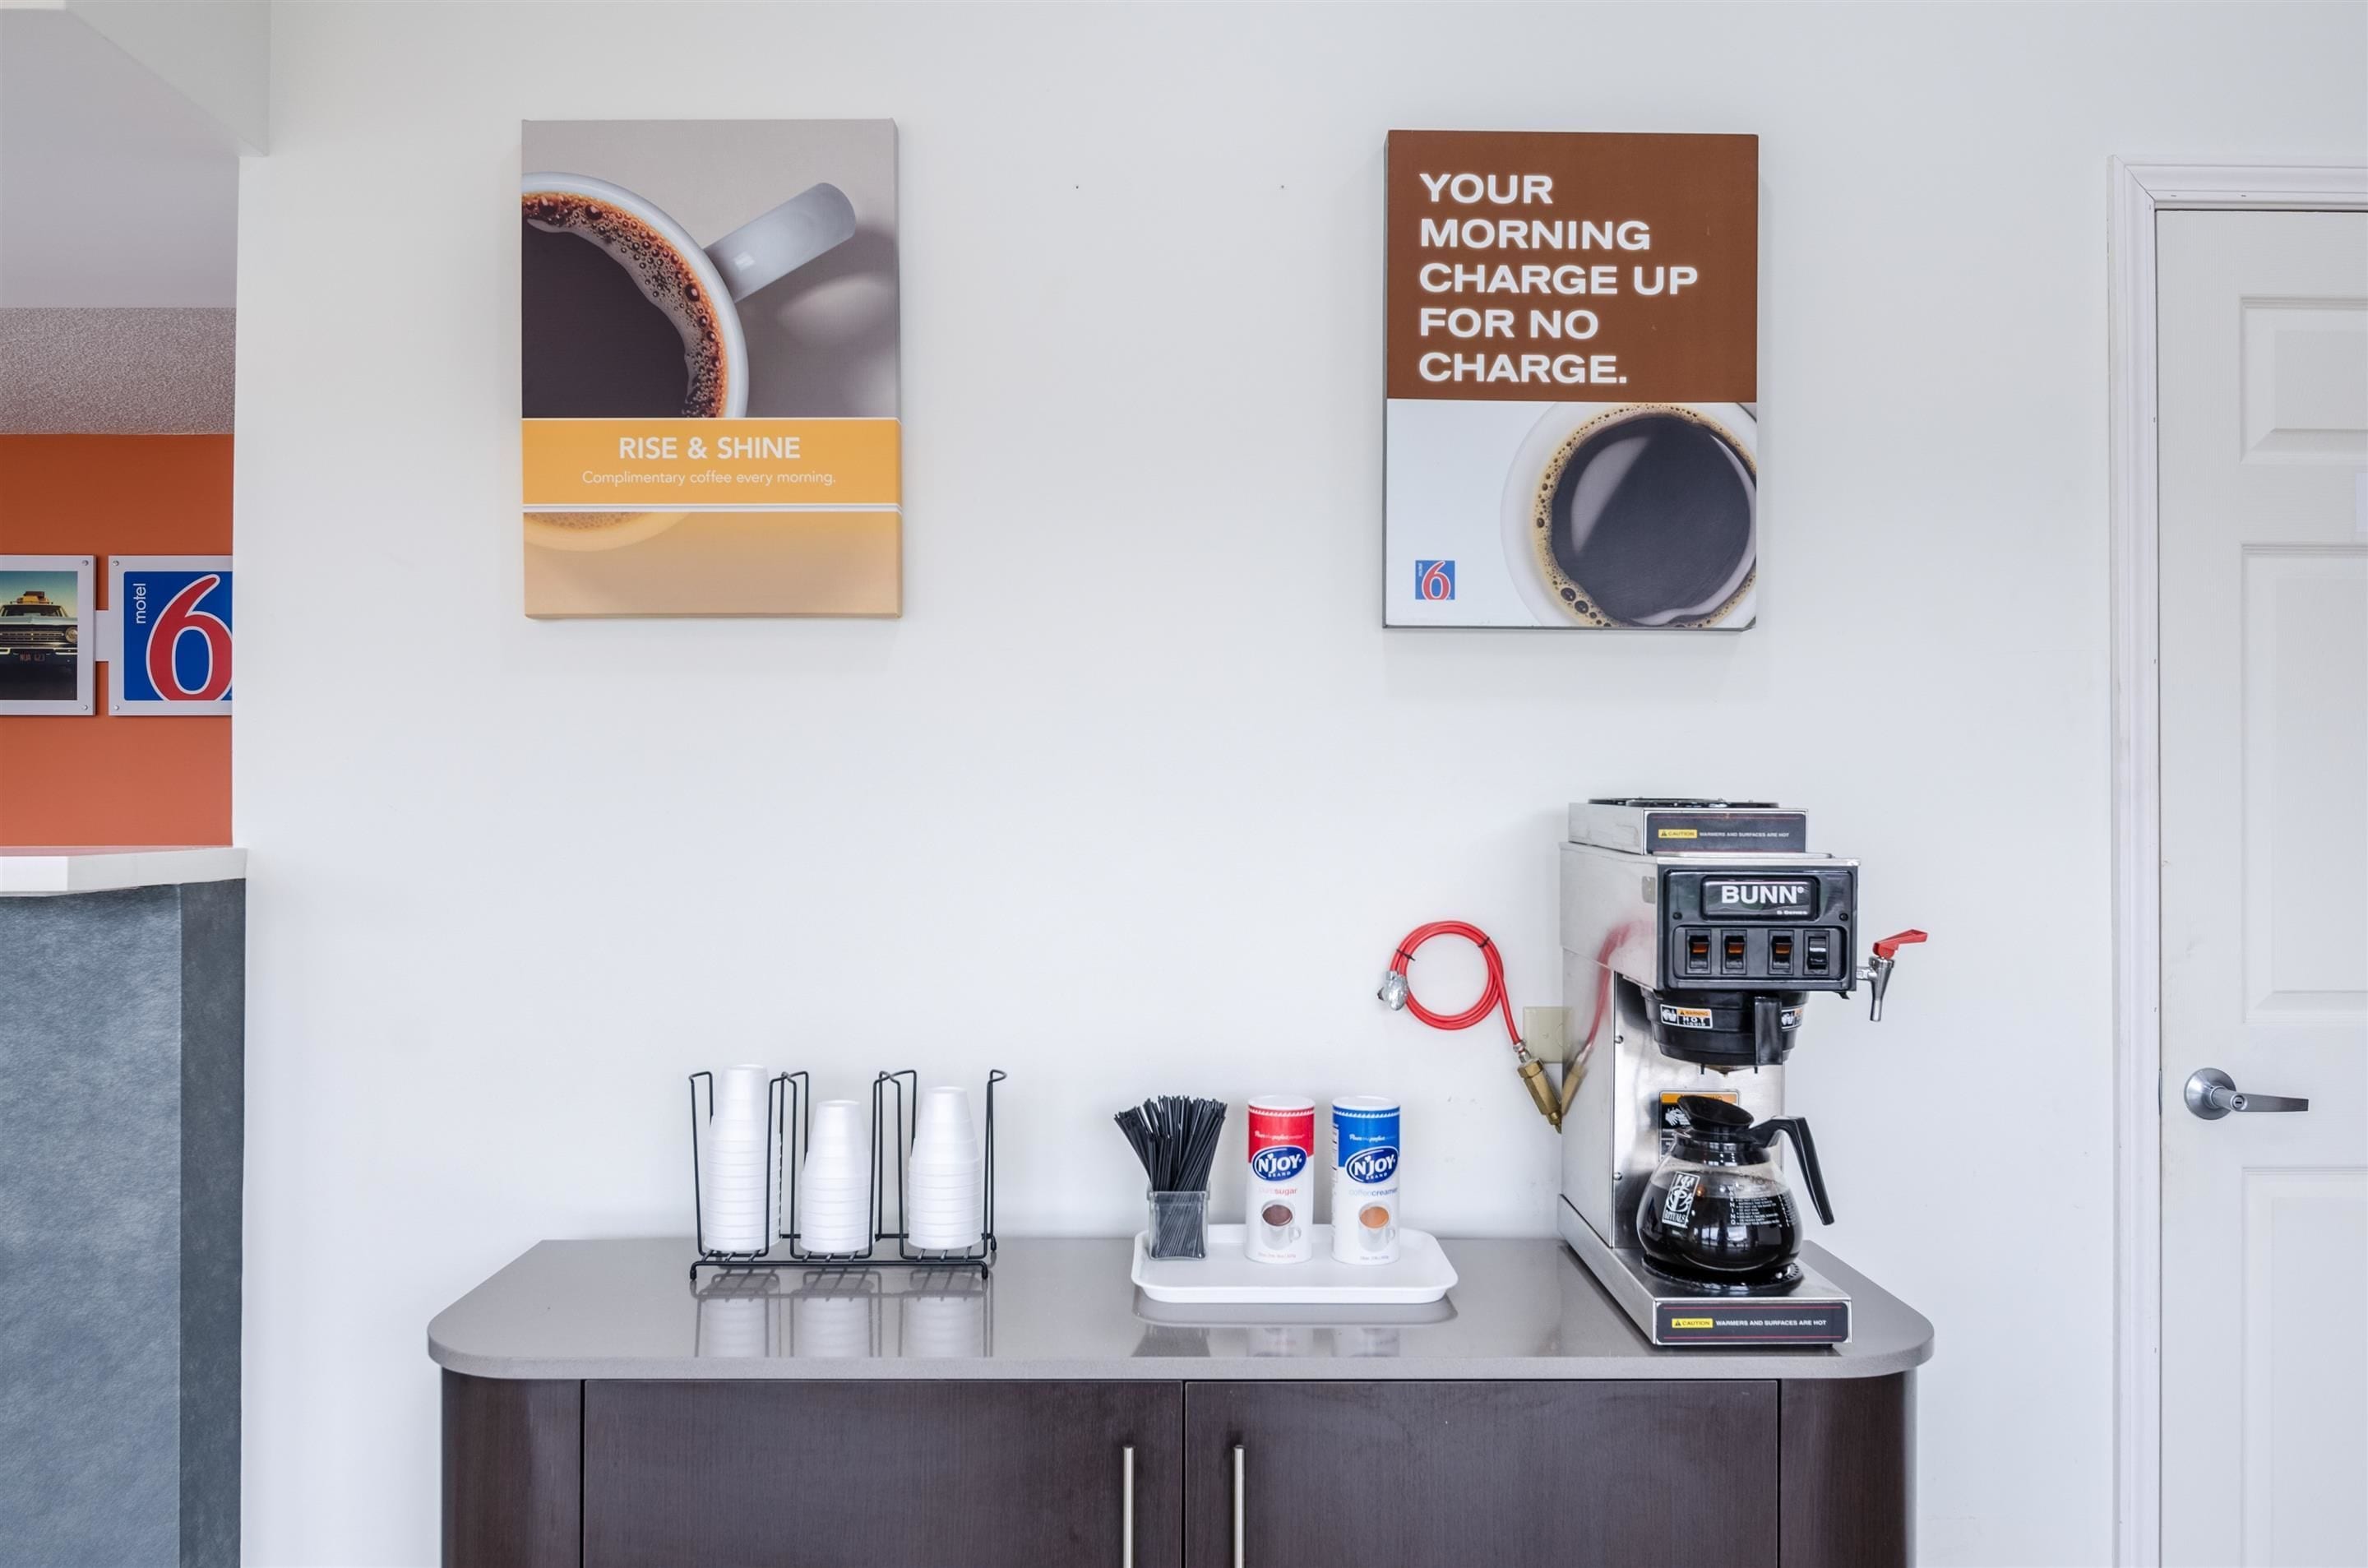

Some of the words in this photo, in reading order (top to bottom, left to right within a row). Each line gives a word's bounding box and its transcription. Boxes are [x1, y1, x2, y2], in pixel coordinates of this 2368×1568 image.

[1419, 173, 1554, 204] YOUR
[1420, 219, 1651, 250] MORNING
[1419, 263, 1618, 294] CHARGE
[1634, 266, 1698, 295] UP
[1420, 308, 1515, 338] FOR
[1530, 310, 1598, 339] NO
[1419, 352, 1627, 383] CHARGE.
[619, 437, 678, 460] RISE
[687, 437, 708, 460] &
[717, 437, 801, 460] SHINE
[582, 470, 686, 487] Complimentary
[690, 470, 732, 483] coffee
[736, 473, 773, 486] every
[777, 470, 836, 487] morning.
[1421, 560, 1451, 600] 6
[133, 582, 146, 624] motel
[146, 573, 233, 701] 6
[1366, 1172, 1388, 1181] BRAND
